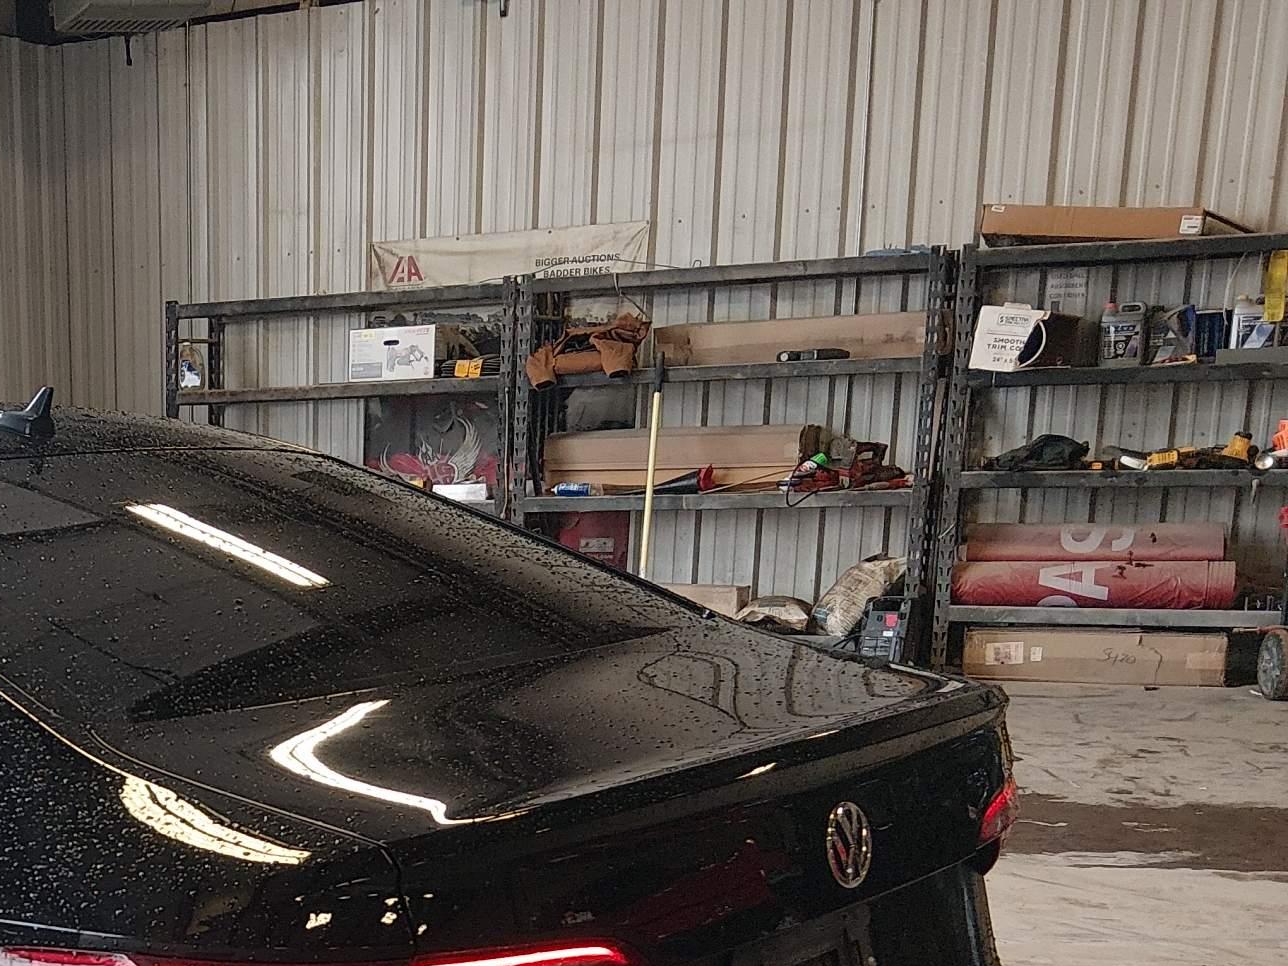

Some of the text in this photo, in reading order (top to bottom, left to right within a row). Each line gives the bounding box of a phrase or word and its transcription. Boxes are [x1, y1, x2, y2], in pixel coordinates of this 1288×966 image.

[535, 252, 621, 267] BIGGER AUCTIONS
[543, 266, 611, 279] BADDER BIKES
[987, 343, 1007, 351] TRIM
